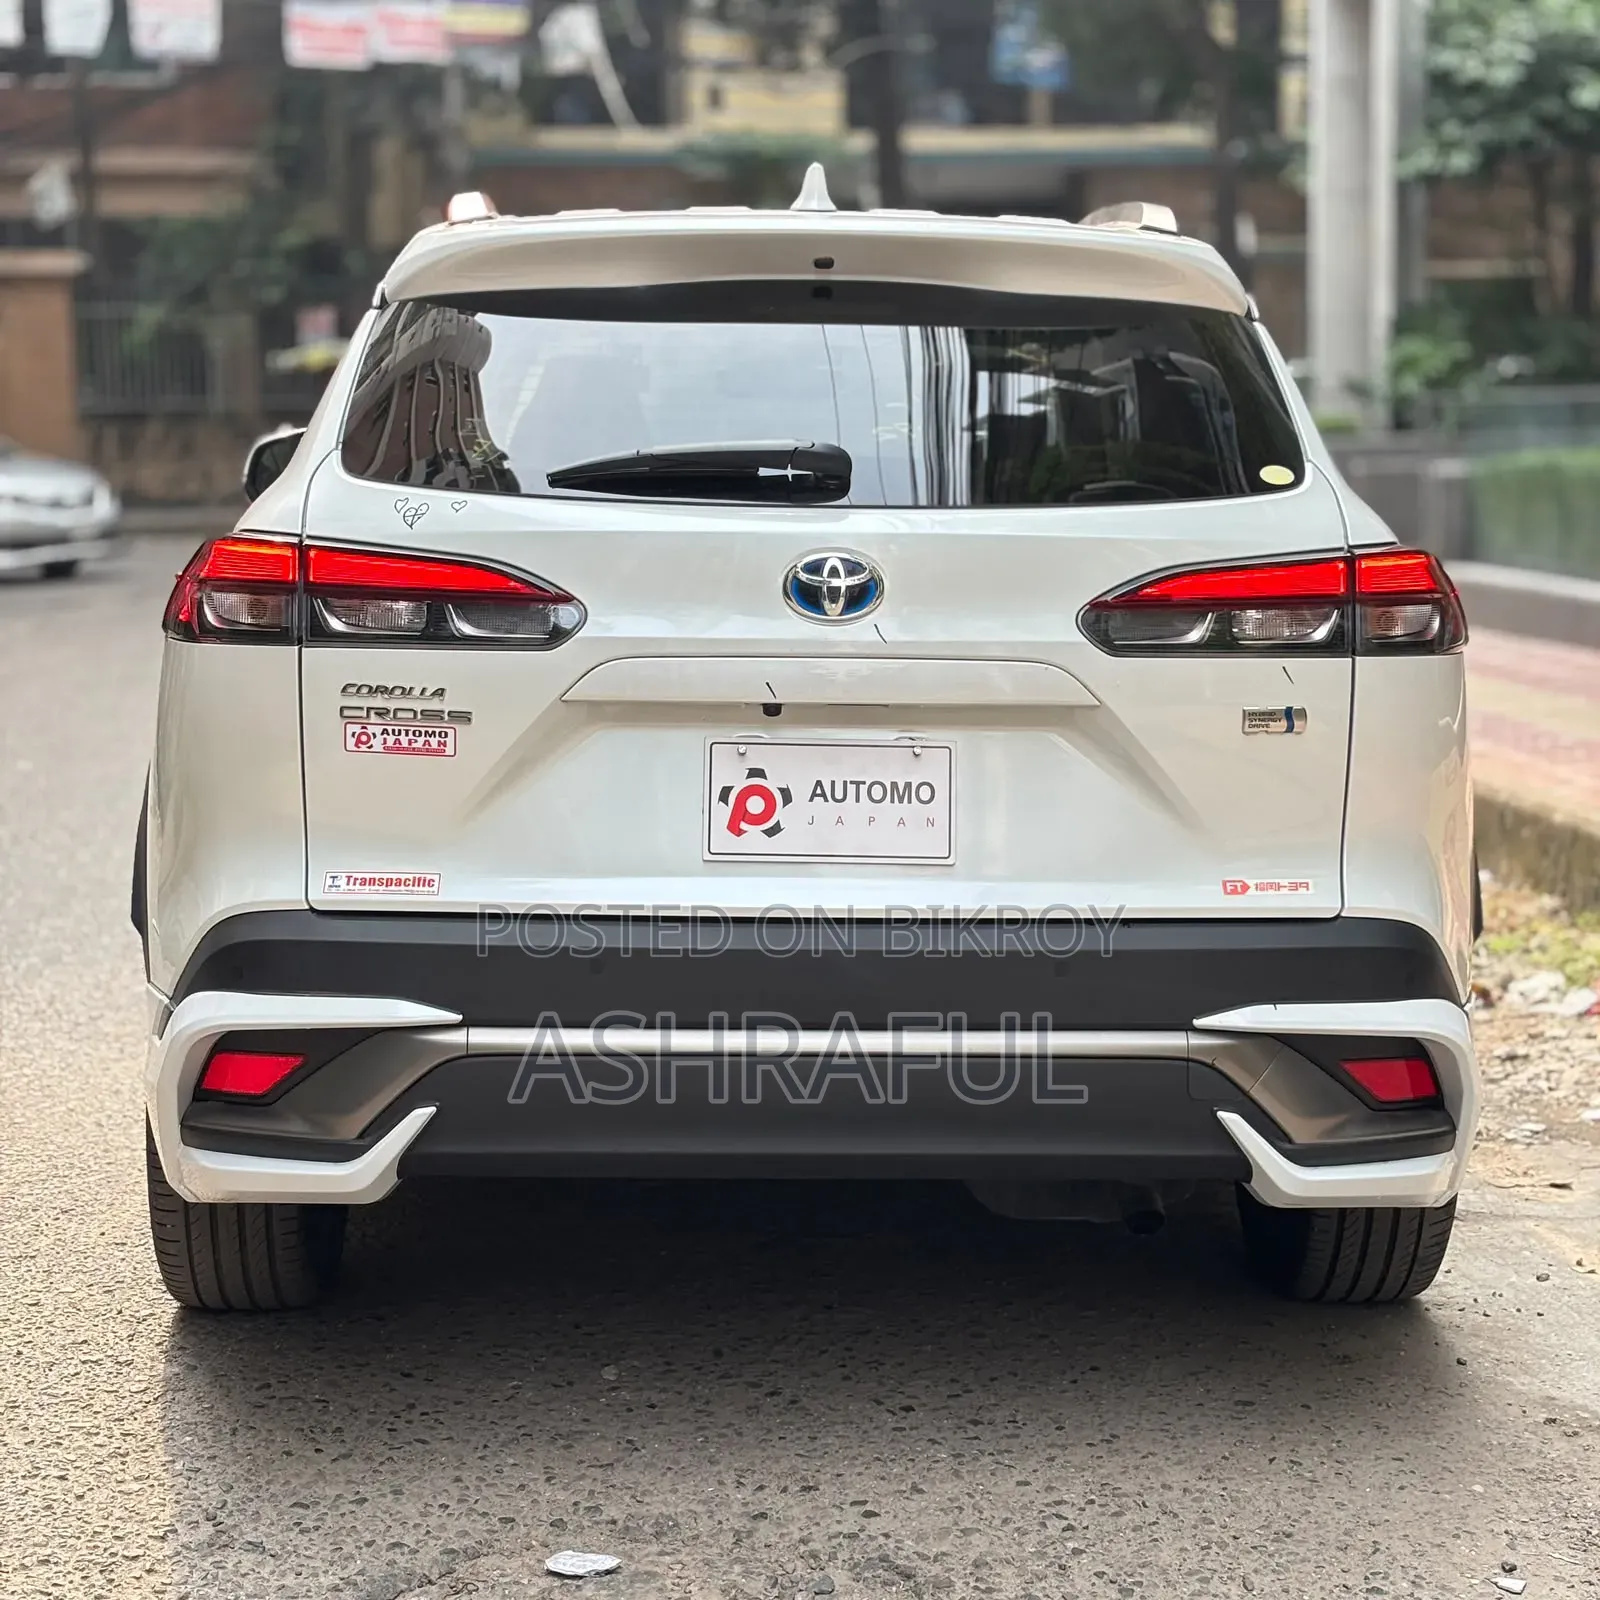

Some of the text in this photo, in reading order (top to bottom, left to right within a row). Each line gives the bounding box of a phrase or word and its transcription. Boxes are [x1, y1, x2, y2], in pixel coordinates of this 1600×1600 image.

[340, 683, 447, 701] COROLLA
[339, 706, 473, 725] CROSS
[380, 728, 449, 739] AUTOMO
[380, 738, 448, 748] JAPAN
[808, 780, 936, 805] AUTOMO
[808, 816, 935, 828] JAPAN
[345, 875, 436, 888] Transpacific
[1226, 882, 1243, 893] FT
